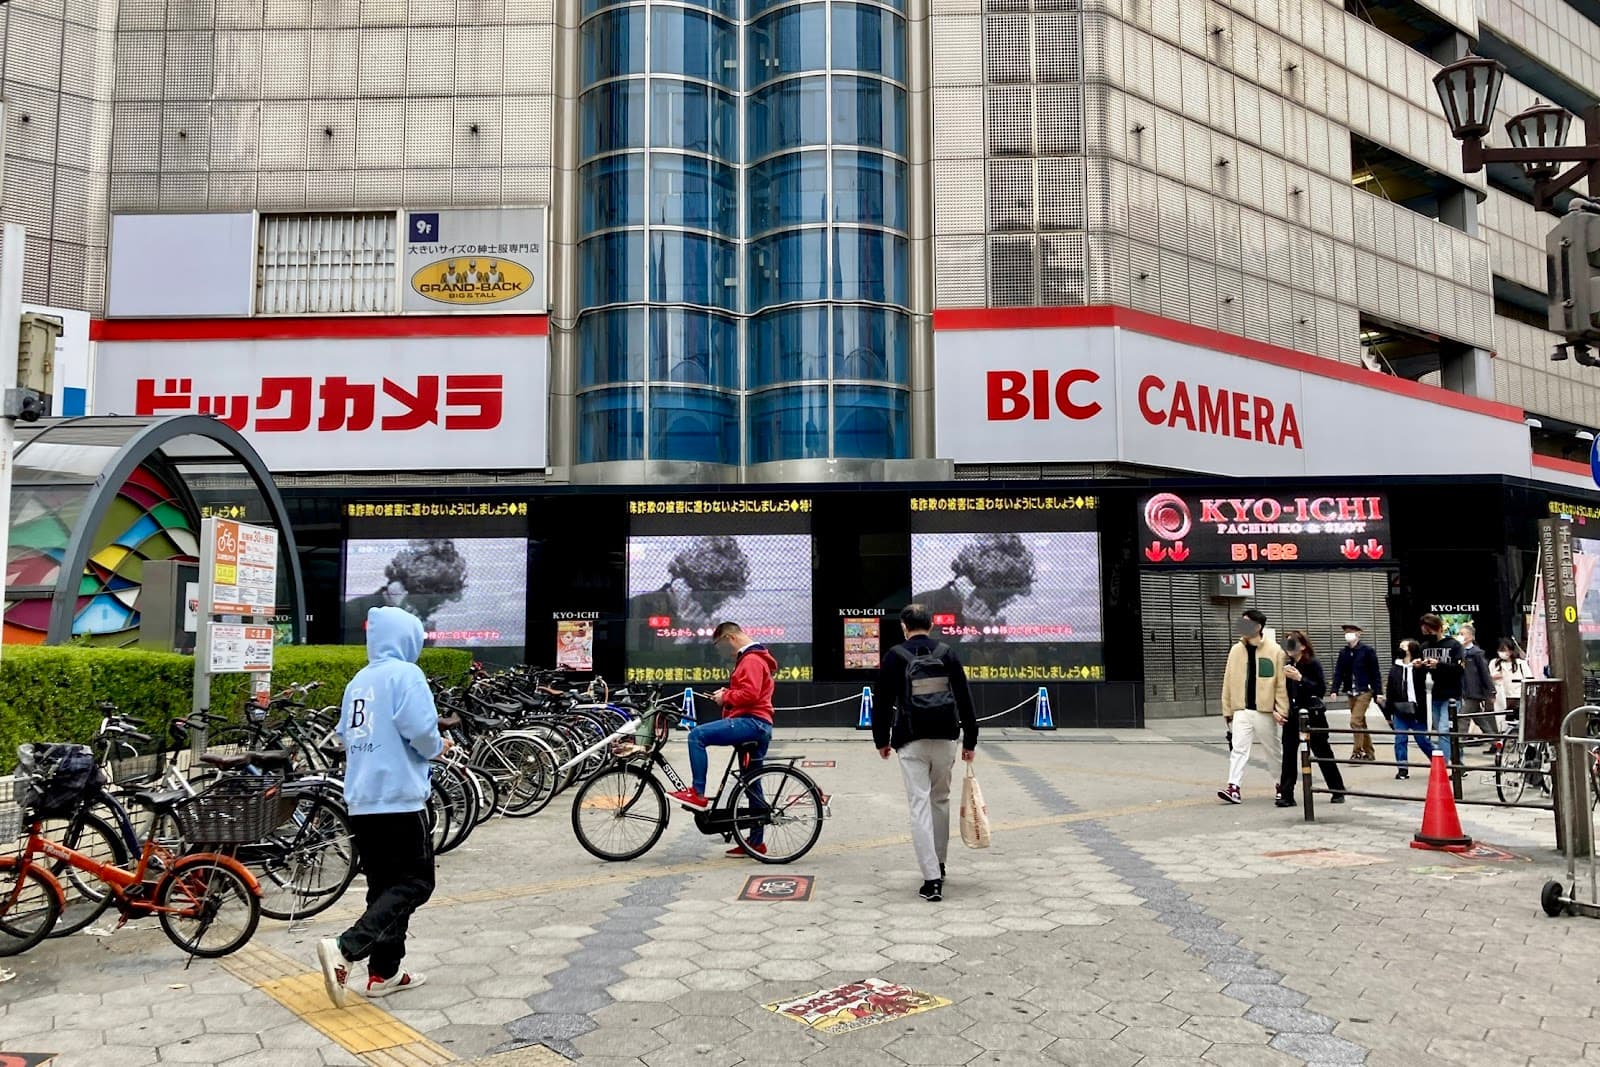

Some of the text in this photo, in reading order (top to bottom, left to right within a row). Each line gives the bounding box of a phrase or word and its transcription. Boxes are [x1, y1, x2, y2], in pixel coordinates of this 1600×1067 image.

[416, 219, 432, 234] 9F
[408, 243, 539, 255] 大きいサイズの紳士服専門店
[420, 282, 522, 293] GRAND-BACK
[136, 374, 503, 432] ビックカメラ
[986, 368, 1303, 450] BIC CAMERA
[1199, 496, 1384, 523] KYO-ICHI
[1217, 523, 1302, 534] PACHINKO
[1324, 522, 1367, 533] SLOT
[350, 699, 365, 728] B
